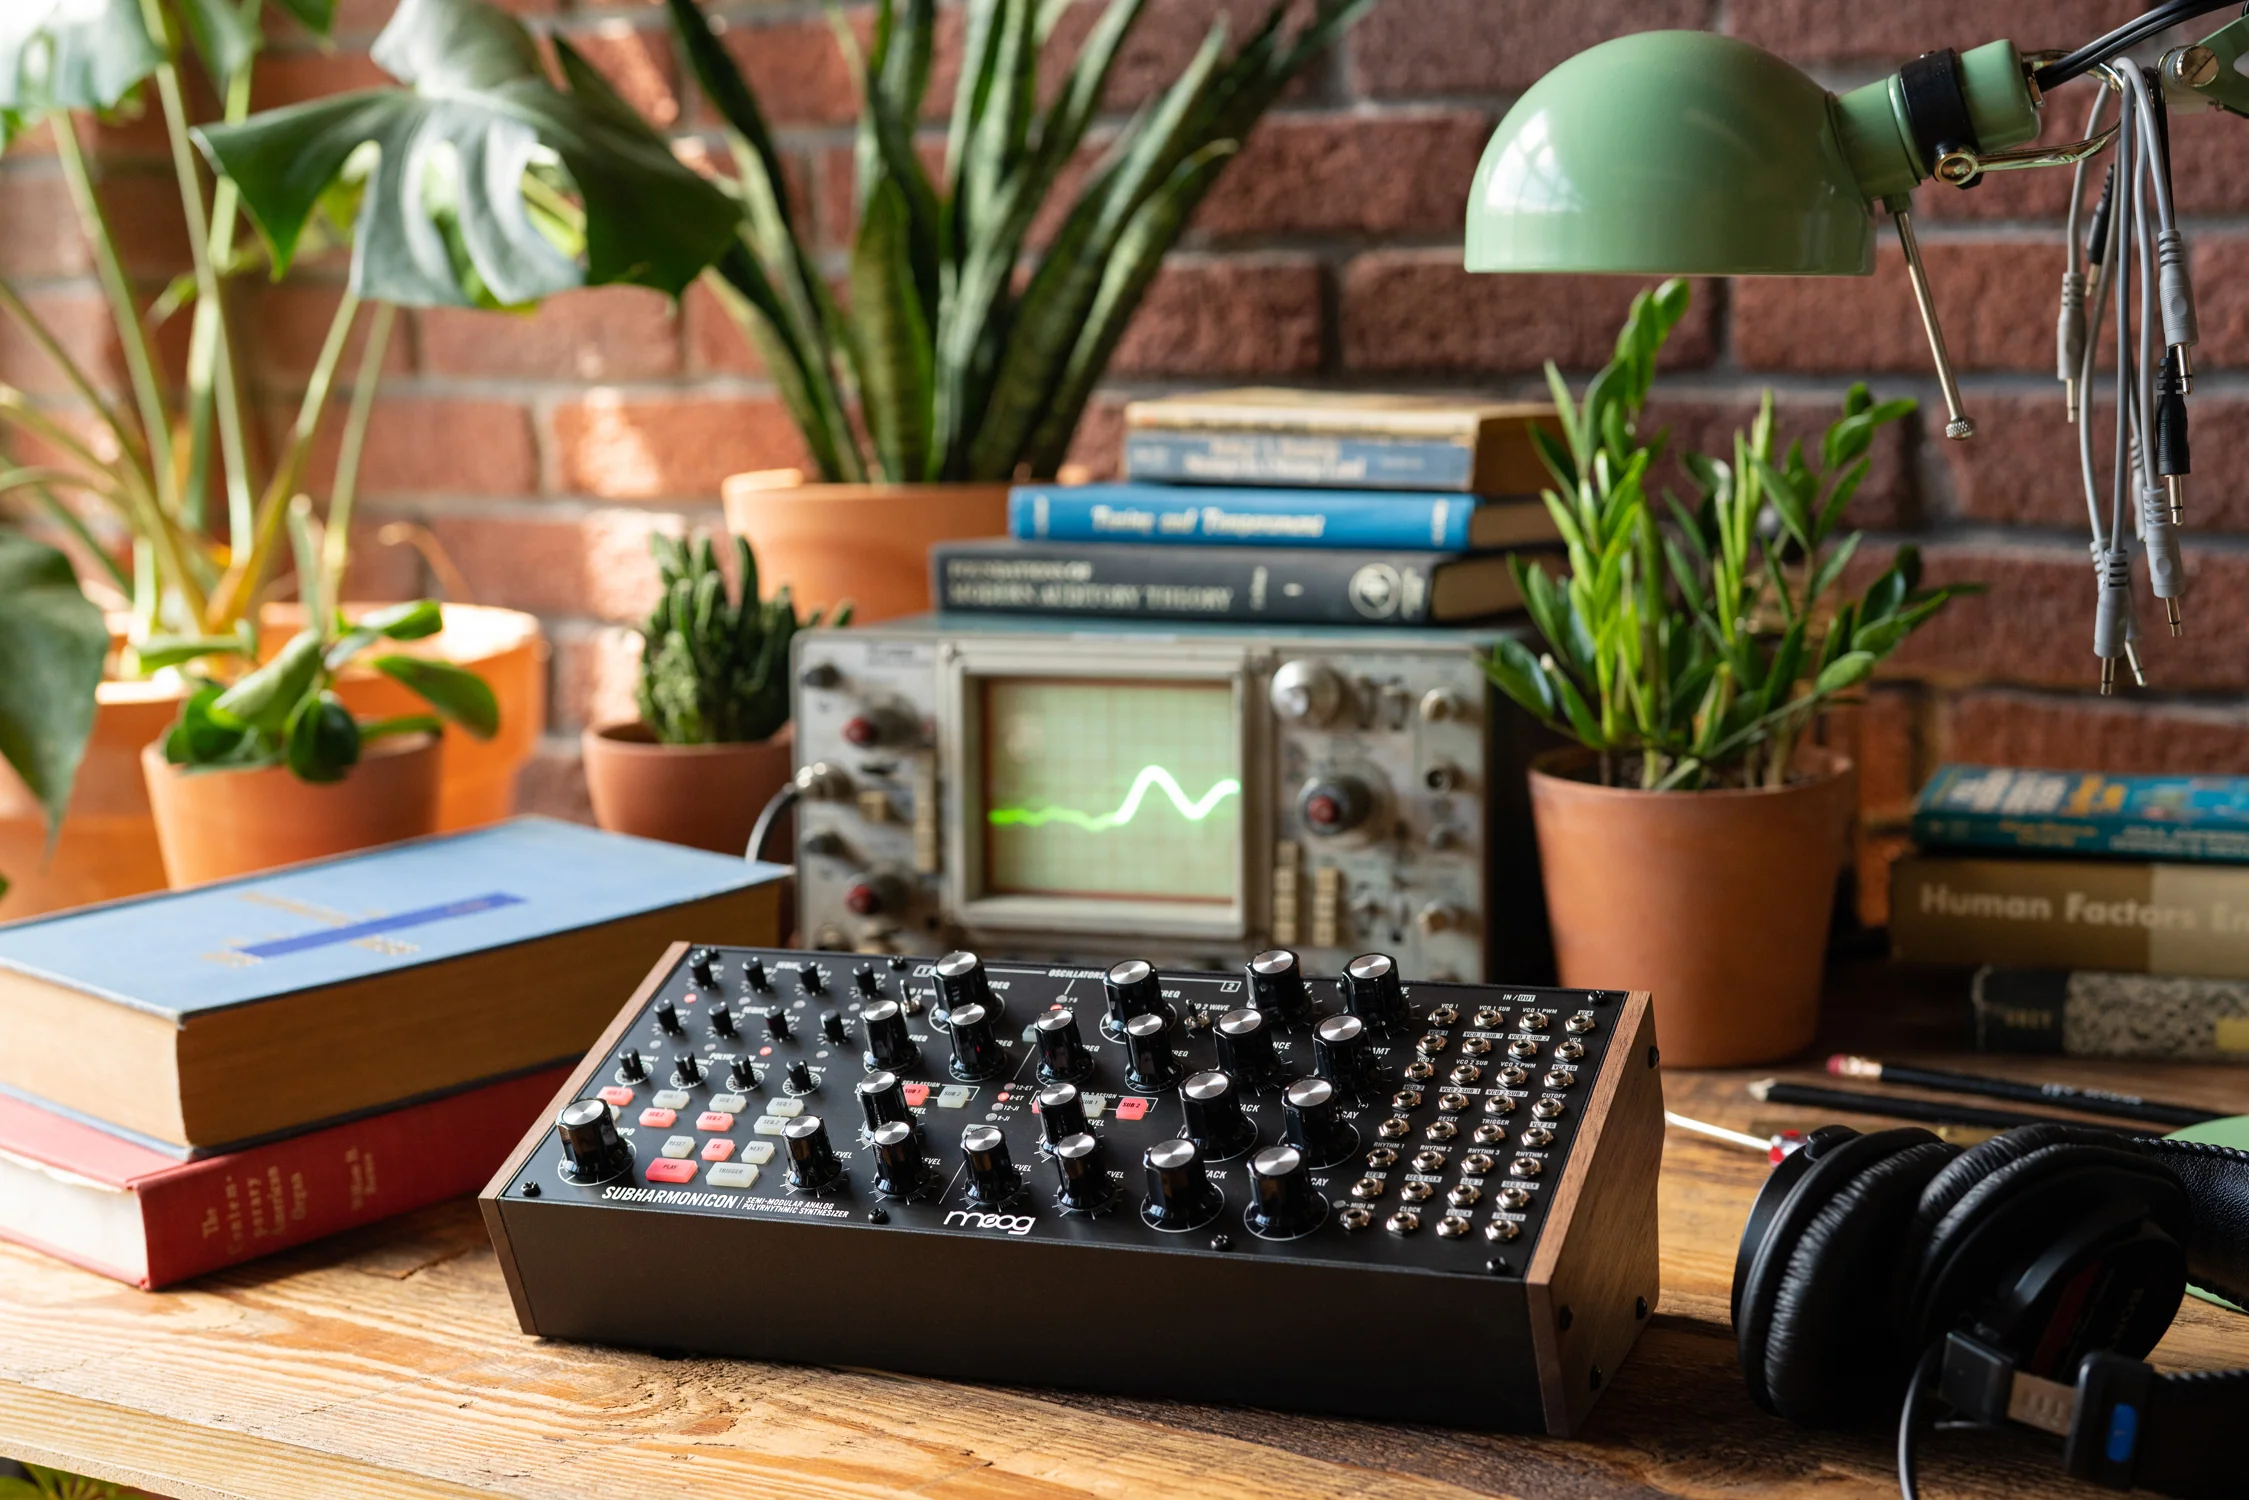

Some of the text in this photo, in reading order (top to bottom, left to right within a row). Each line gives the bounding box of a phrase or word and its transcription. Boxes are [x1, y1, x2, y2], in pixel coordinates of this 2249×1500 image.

[1920, 883, 2051, 921] Human
[2064, 891, 2196, 930] Factors
[1048, 969, 1105, 979] OSCILLATORS
[1161, 990, 1181, 998] REQ
[833, 1151, 852, 1159] EVEL
[1106, 1171, 1124, 1179] EVEL
[602, 1186, 738, 1208] SUBHARMONICON
[746, 1197, 834, 1209] SEMI-MODULAR ANALOG
[742, 1204, 849, 1218] POLYRHYTHMIC SYNTHESIZER
[202, 1207, 219, 1237] The
[943, 1211, 1036, 1235] moog
